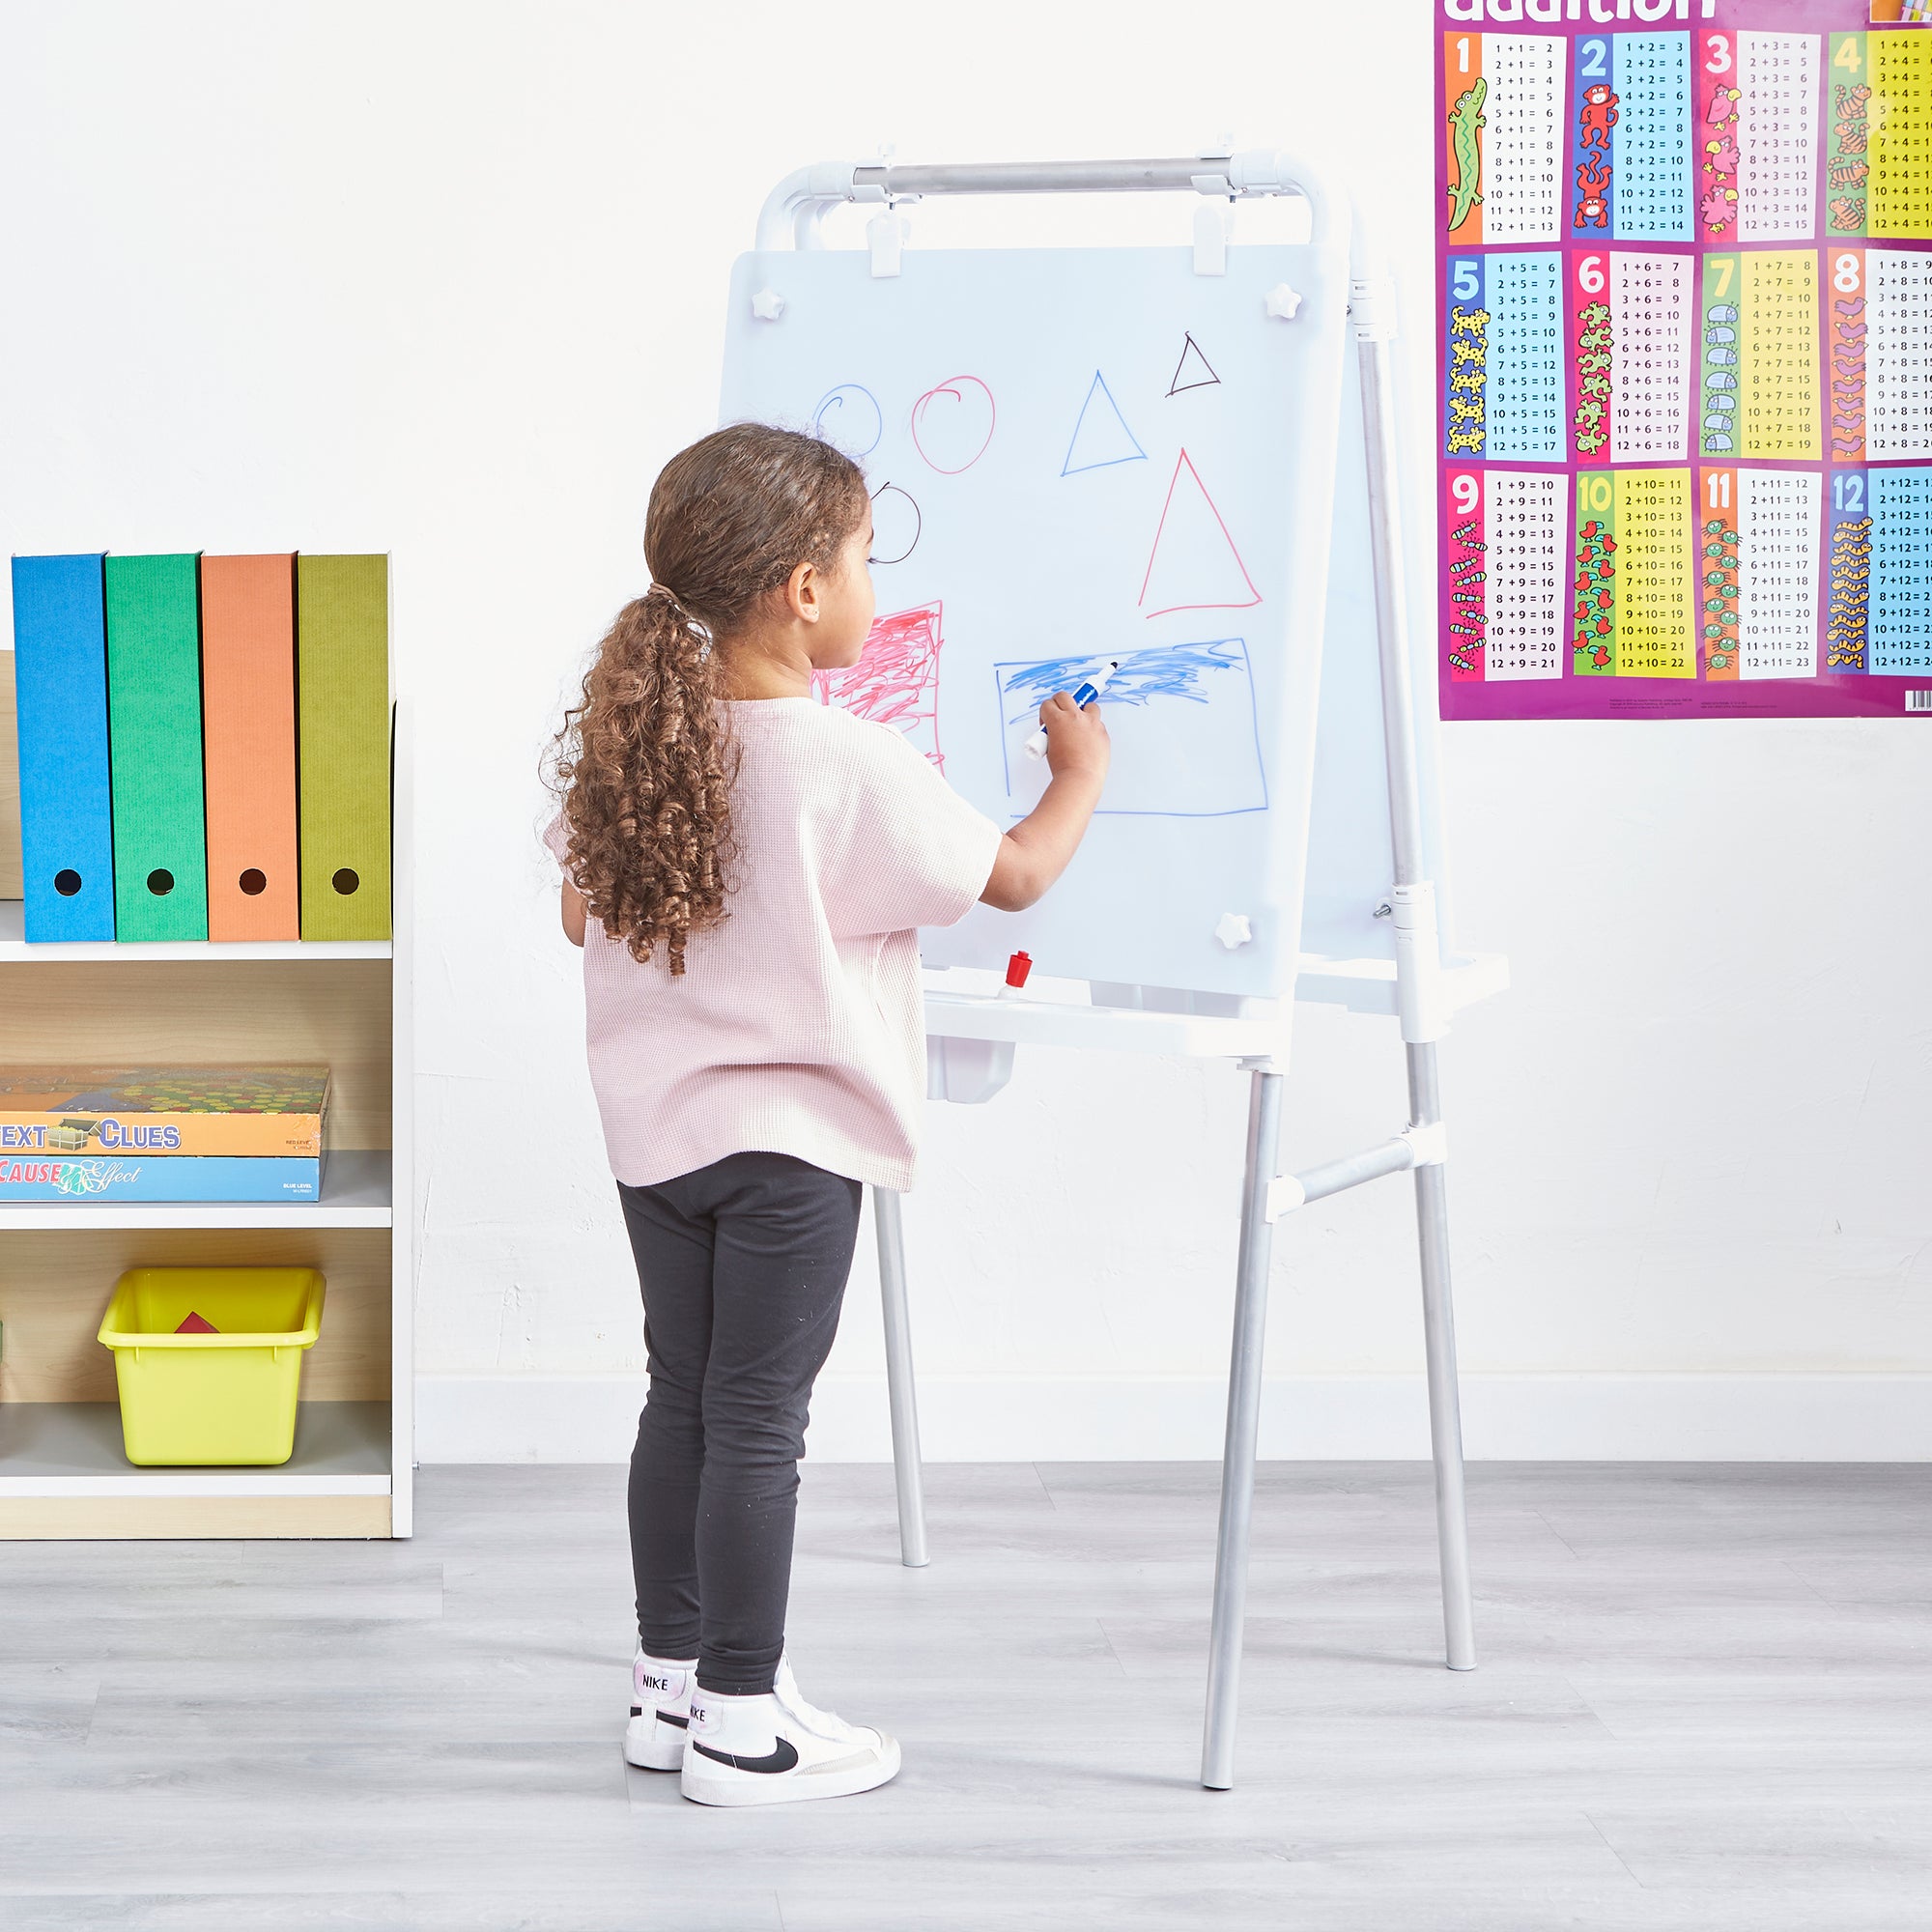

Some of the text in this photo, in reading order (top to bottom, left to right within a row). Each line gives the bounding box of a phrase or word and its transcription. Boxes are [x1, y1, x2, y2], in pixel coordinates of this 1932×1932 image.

[1496, 43, 1500, 53] 1
[1519, 43, 1523, 53] 1
[1546, 43, 1552, 53] 2
[1880, 40, 1885, 50] 1
[1891, 41, 1899, 49] +
[1901, 40, 1910, 50] 4
[1456, 38, 1470, 73] 1
[1581, 39, 1607, 76] 2
[1705, 35, 1732, 73] 3
[1833, 37, 1861, 73] 4
[1626, 58, 1633, 69] 2
[1648, 58, 1655, 69] 2
[1676, 58, 1684, 68] 4
[1748, 90, 1757, 99] 4
[1772, 89, 1779, 99] 3
[1800, 89, 1807, 99] 7
[1494, 173, 1503, 183] 9
[1520, 173, 1523, 183] 1
[1541, 173, 1553, 183] 10
[1745, 203, 1756, 213] 11
[1762, 204, 1770, 213] +
[1773, 203, 1779, 213] 3
[1795, 203, 1808, 213] 14
[1621, 220, 1634, 231] 12
[1638, 221, 1645, 230] +
[1648, 220, 1656, 231] 2
[1670, 220, 1684, 231] 14
[1874, 218, 1888, 229] 12
[1891, 219, 1899, 228] +
[1901, 218, 1910, 229] 4
[1498, 264, 1503, 273] 1
[1510, 264, 1517, 272] +
[1520, 263, 1527, 273] 5
[1548, 263, 1556, 272] 6
[1879, 260, 1884, 270] 1
[1900, 260, 1908, 270] 8
[1924, 260, 1932, 270] 9
[1577, 256, 1605, 294] 6
[1710, 259, 1735, 298] 7
[1833, 253, 1860, 293] 8
[1452, 261, 1480, 299] 5
[1878, 276, 1886, 287] 2
[1900, 276, 1908, 287] 8
[1622, 295, 1629, 304] 3
[1644, 294, 1652, 304] 6
[1672, 294, 1680, 304] 9
[1753, 326, 1760, 336] 5
[1765, 327, 1773, 335] +
[1776, 326, 1782, 336] 7
[1798, 326, 1811, 336] 12
[1497, 344, 1505, 355] 6
[1520, 344, 1527, 355] 5
[1543, 344, 1554, 354] 11
[1617, 408, 1631, 418] 10
[1634, 409, 1641, 417] +
[1644, 408, 1652, 418] 6
[1666, 408, 1680, 417] 16
[1492, 441, 1506, 451] 12
[1520, 441, 1528, 451] 5
[1544, 440, 1556, 451] 17
[1747, 440, 1761, 450] 12
[1776, 440, 1783, 449] 7
[1798, 439, 1811, 449] 19
[1452, 475, 1479, 514] 9
[1579, 477, 1612, 512] 10
[1707, 472, 1731, 508] 11
[1833, 474, 1864, 512] 12
[1625, 496, 1633, 506] 2
[1644, 496, 1657, 506] 10
[1669, 496, 1683, 505] 12
[1879, 494, 1887, 504] 2
[1898, 494, 1912, 504] 12
[1750, 511, 1757, 522] 3
[1770, 511, 1781, 522] 11
[1796, 511, 1808, 521] 14
[1495, 529, 1503, 539] 4
[1518, 528, 1526, 539] 9
[1541, 528, 1554, 539] 13
[1621, 625, 1634, 636] 10
[1645, 625, 1659, 636] 10
[1670, 625, 1686, 636] 20
[1491, 642, 1503, 652] 11
[1519, 642, 1526, 652] 9
[1541, 642, 1556, 652] 20
[1747, 657, 1760, 668] 12
[1771, 657, 1782, 668] 11
[1796, 657, 1809, 668] 23
[1874, 656, 1888, 667] 12
[1898, 656, 1912, 667] 12
[0, 1118, 182, 1150] EXT CLUES
[80, 1159, 144, 1193] Effect
[642, 1674, 668, 1691] NIKE
